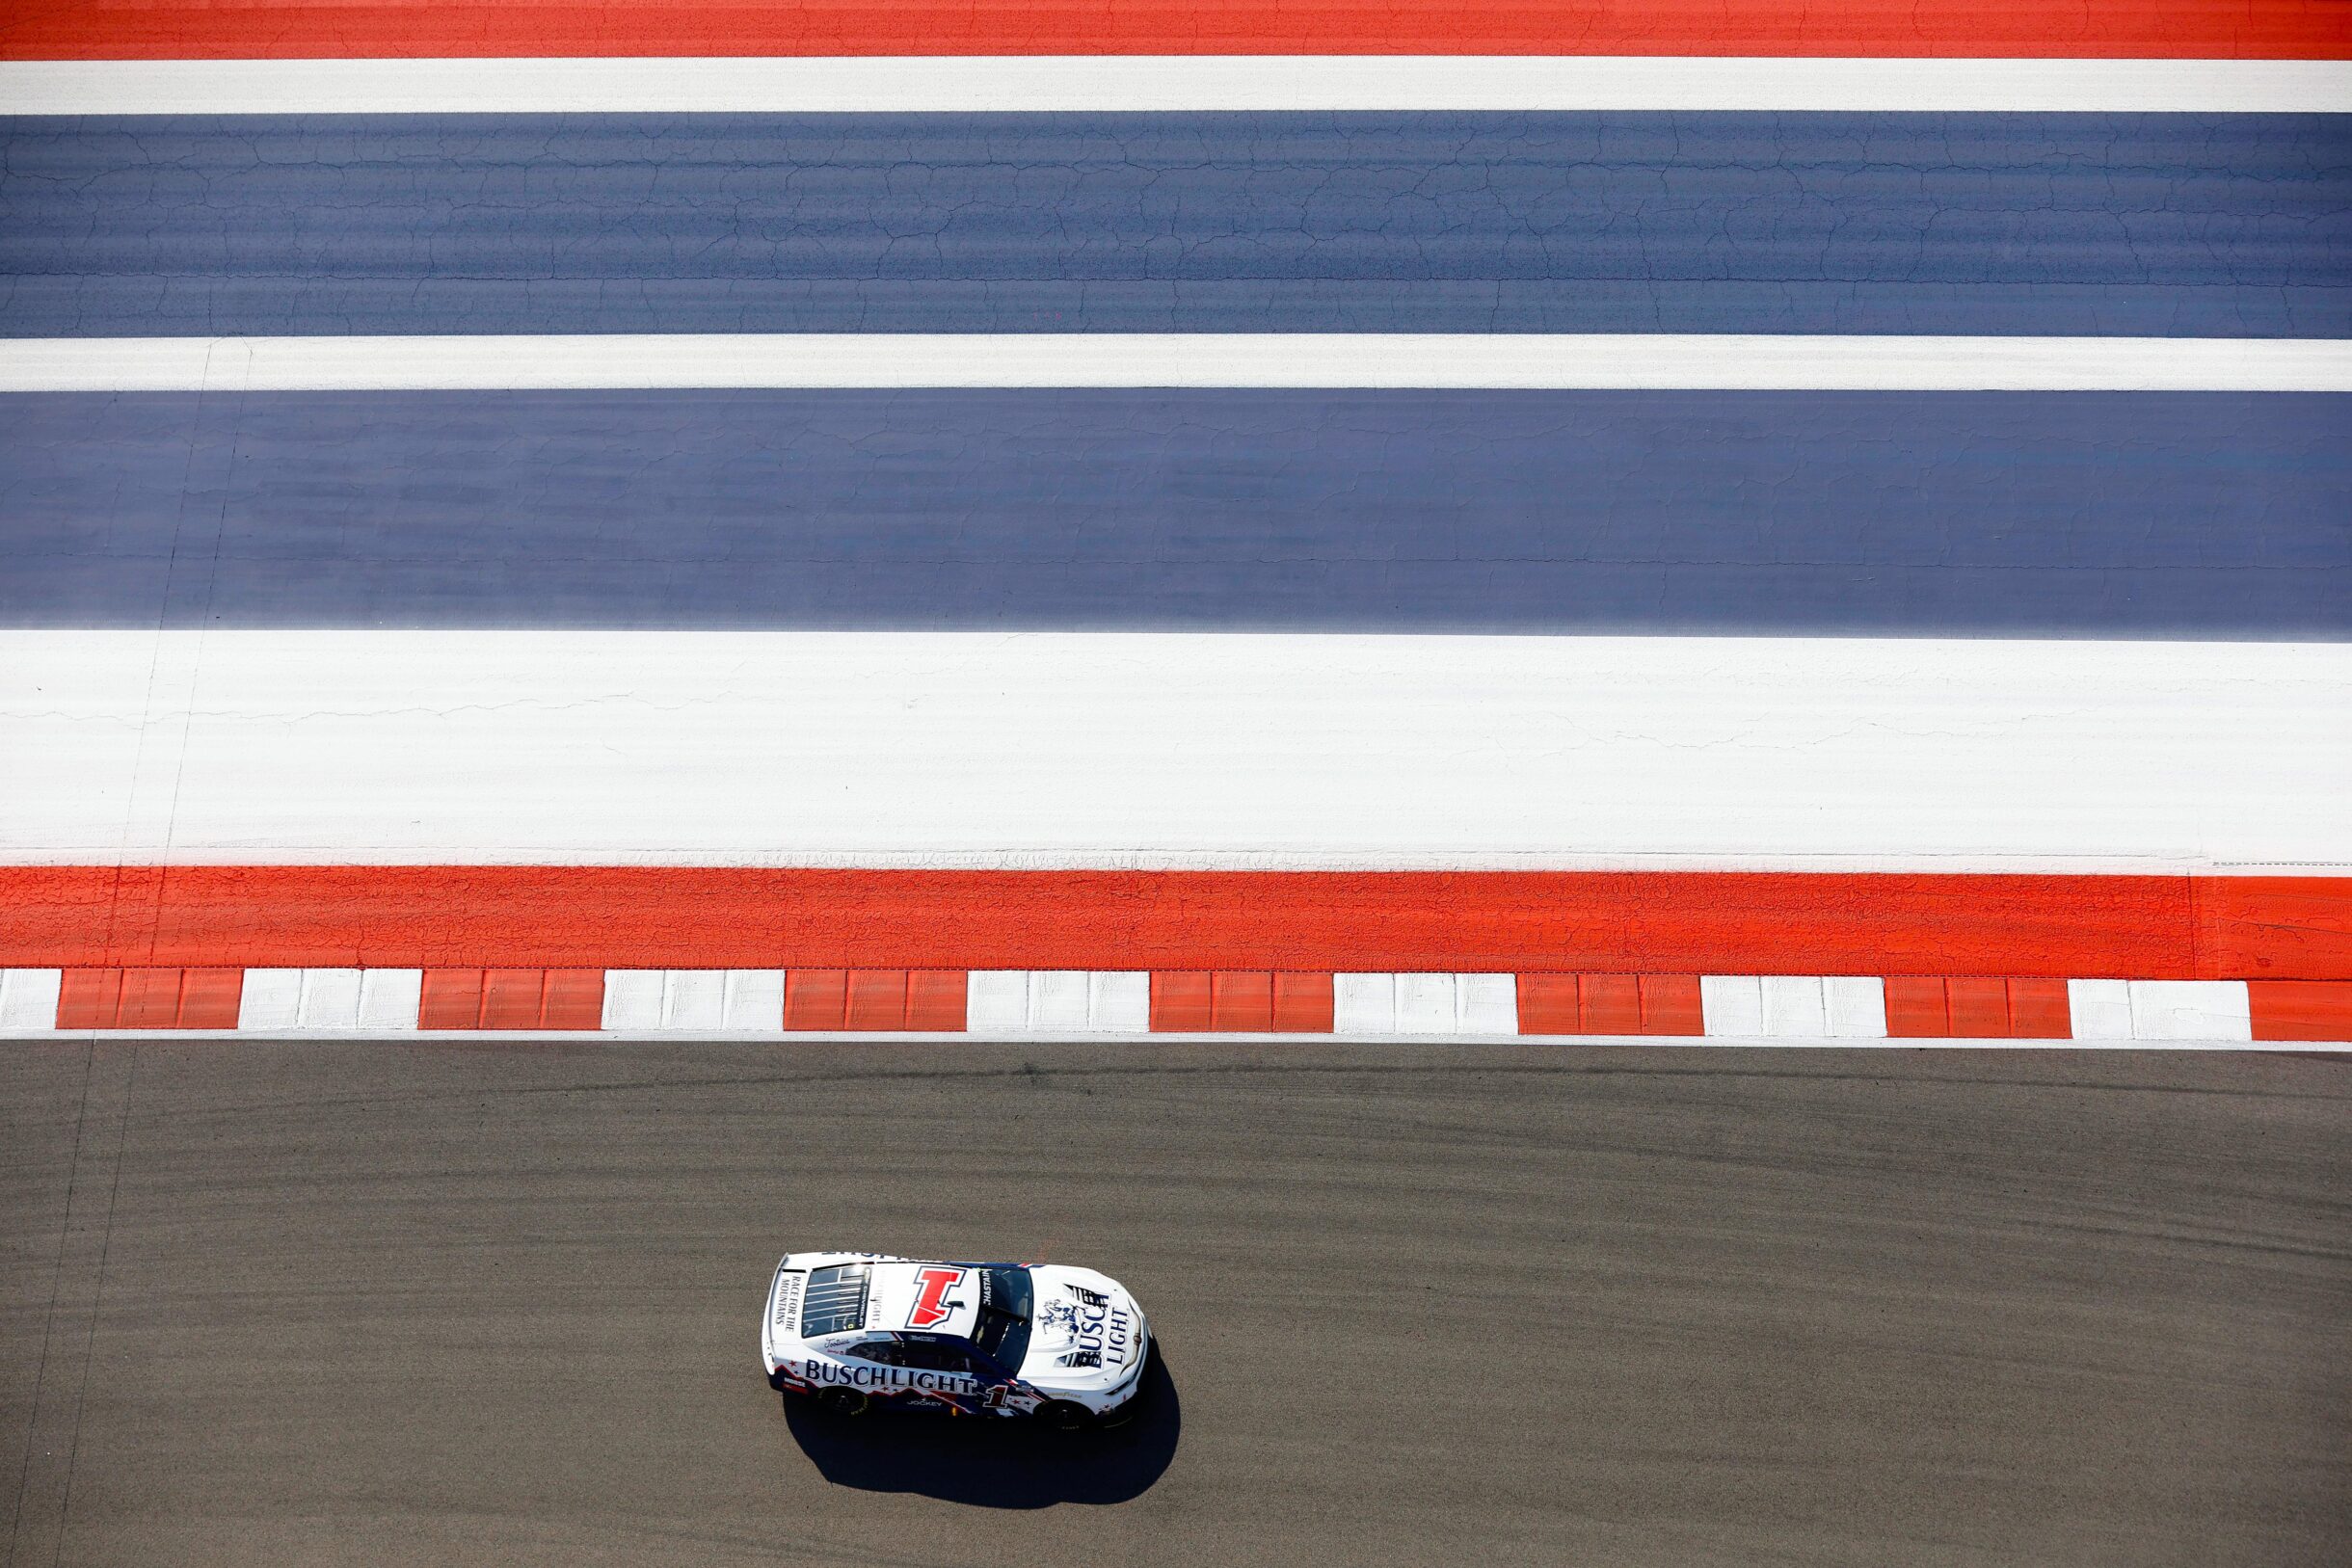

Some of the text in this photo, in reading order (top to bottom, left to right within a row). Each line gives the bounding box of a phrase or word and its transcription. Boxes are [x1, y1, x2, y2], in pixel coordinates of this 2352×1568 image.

[776, 1279, 790, 1325] MOUNTAINS
[786, 1276, 801, 1332] RACE FOR THE
[859, 1286, 868, 1327] CHEVROLET
[904, 1265, 967, 1330] 1
[1107, 1307, 1128, 1365] LIGHT
[982, 1384, 1009, 1409] 1
